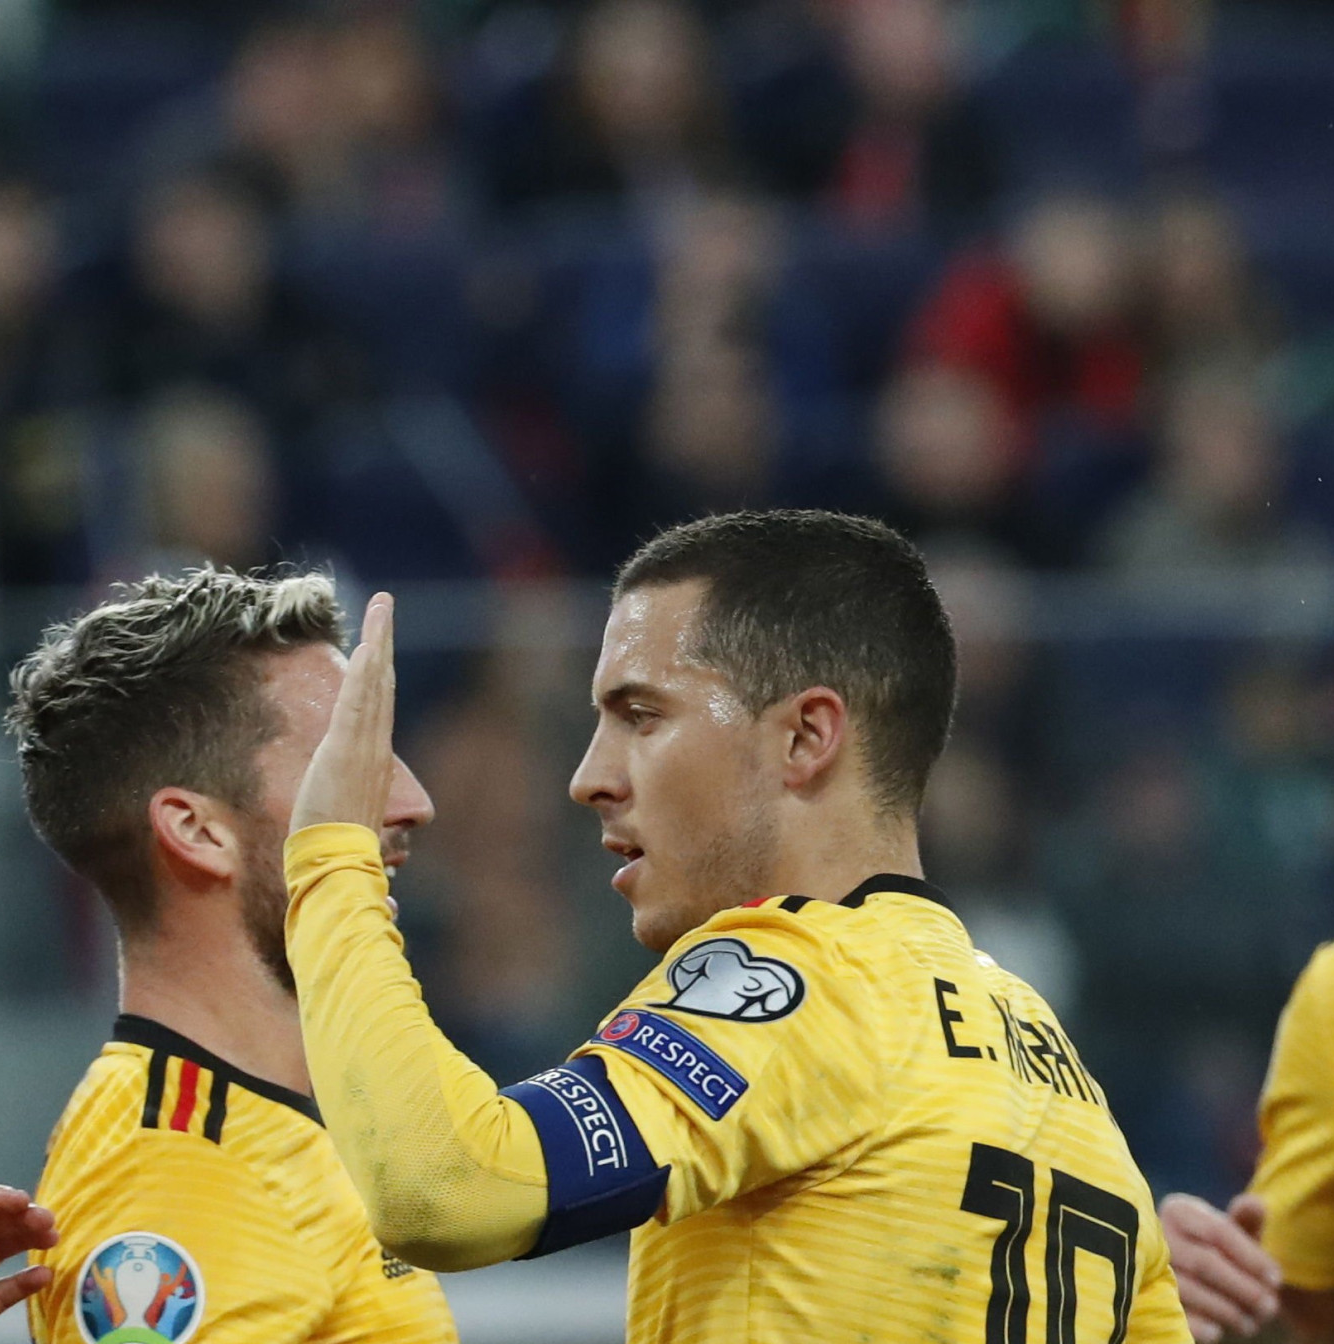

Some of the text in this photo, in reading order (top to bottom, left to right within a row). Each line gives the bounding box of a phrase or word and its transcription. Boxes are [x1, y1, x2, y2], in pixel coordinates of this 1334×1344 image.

[933, 976, 998, 1063] E.
[632, 1024, 740, 1107] RESPECT
[535, 1070, 620, 1169] RESPECT
